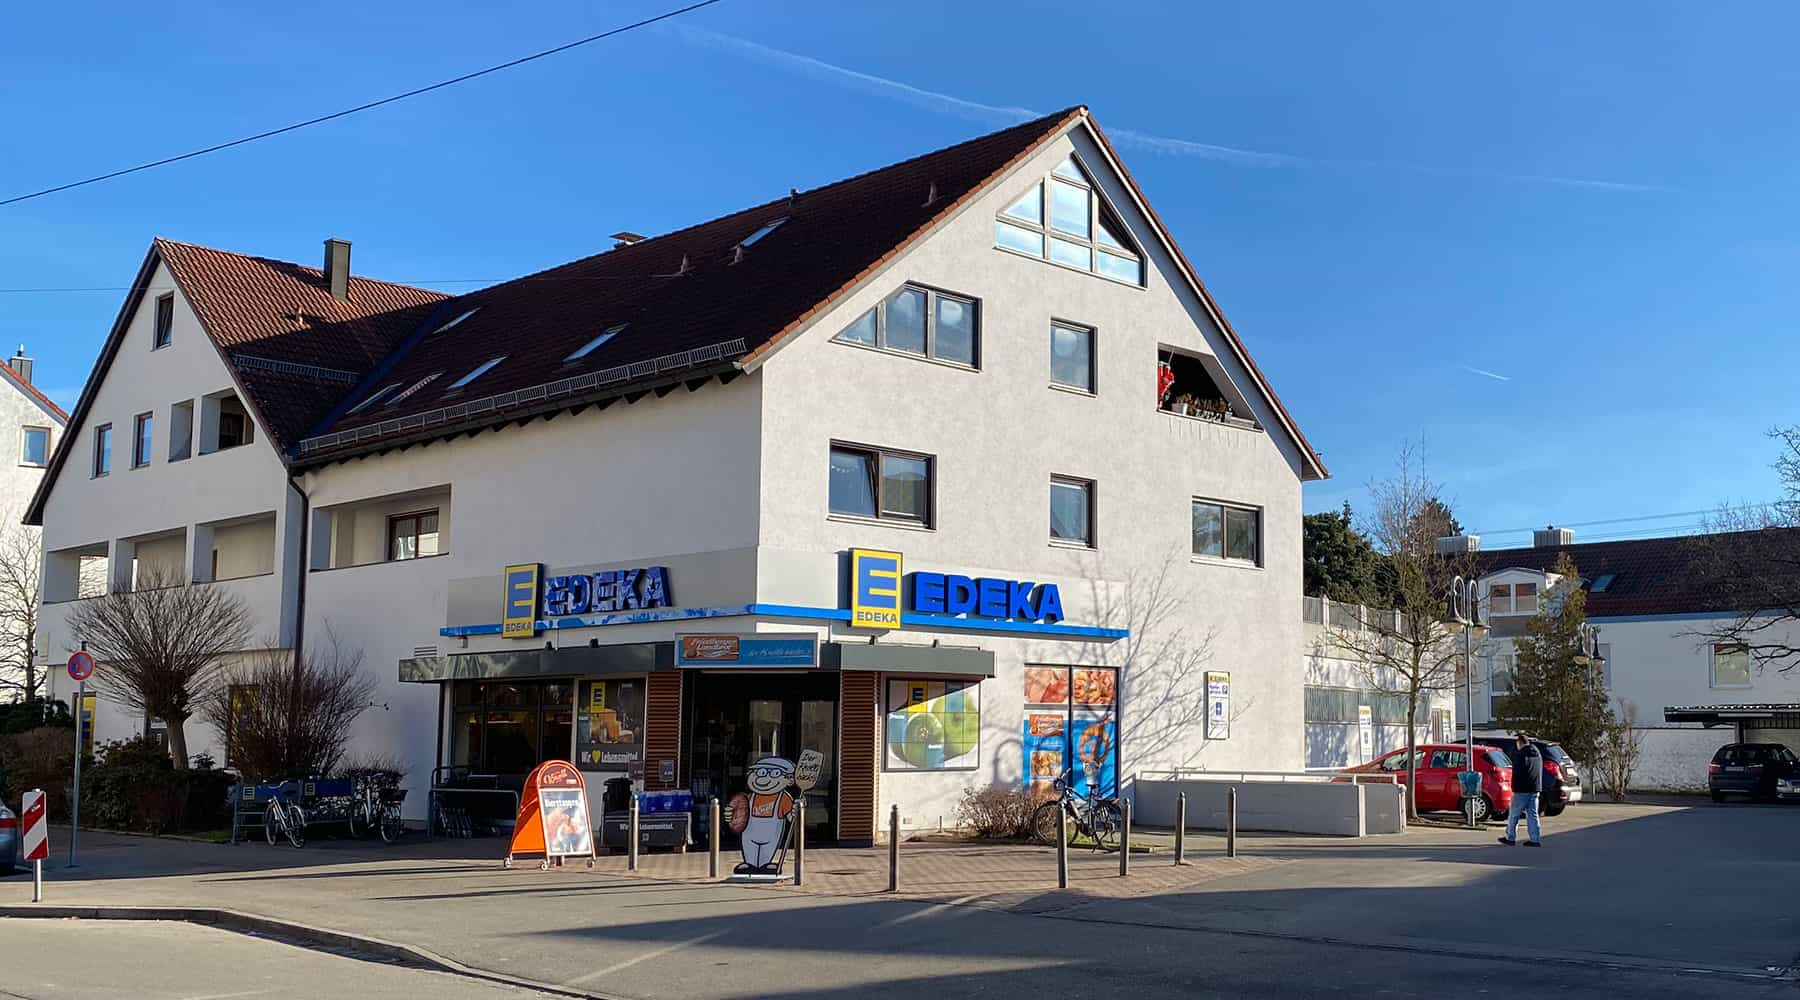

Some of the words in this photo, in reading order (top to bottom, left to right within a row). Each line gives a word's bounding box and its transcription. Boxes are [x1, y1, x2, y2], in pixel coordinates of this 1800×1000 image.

[544, 566, 672, 617] EDEKA
[913, 571, 1065, 621] EDEKA
[505, 622, 531, 633] EDEKA
[857, 611, 897, 624] EDEKA
